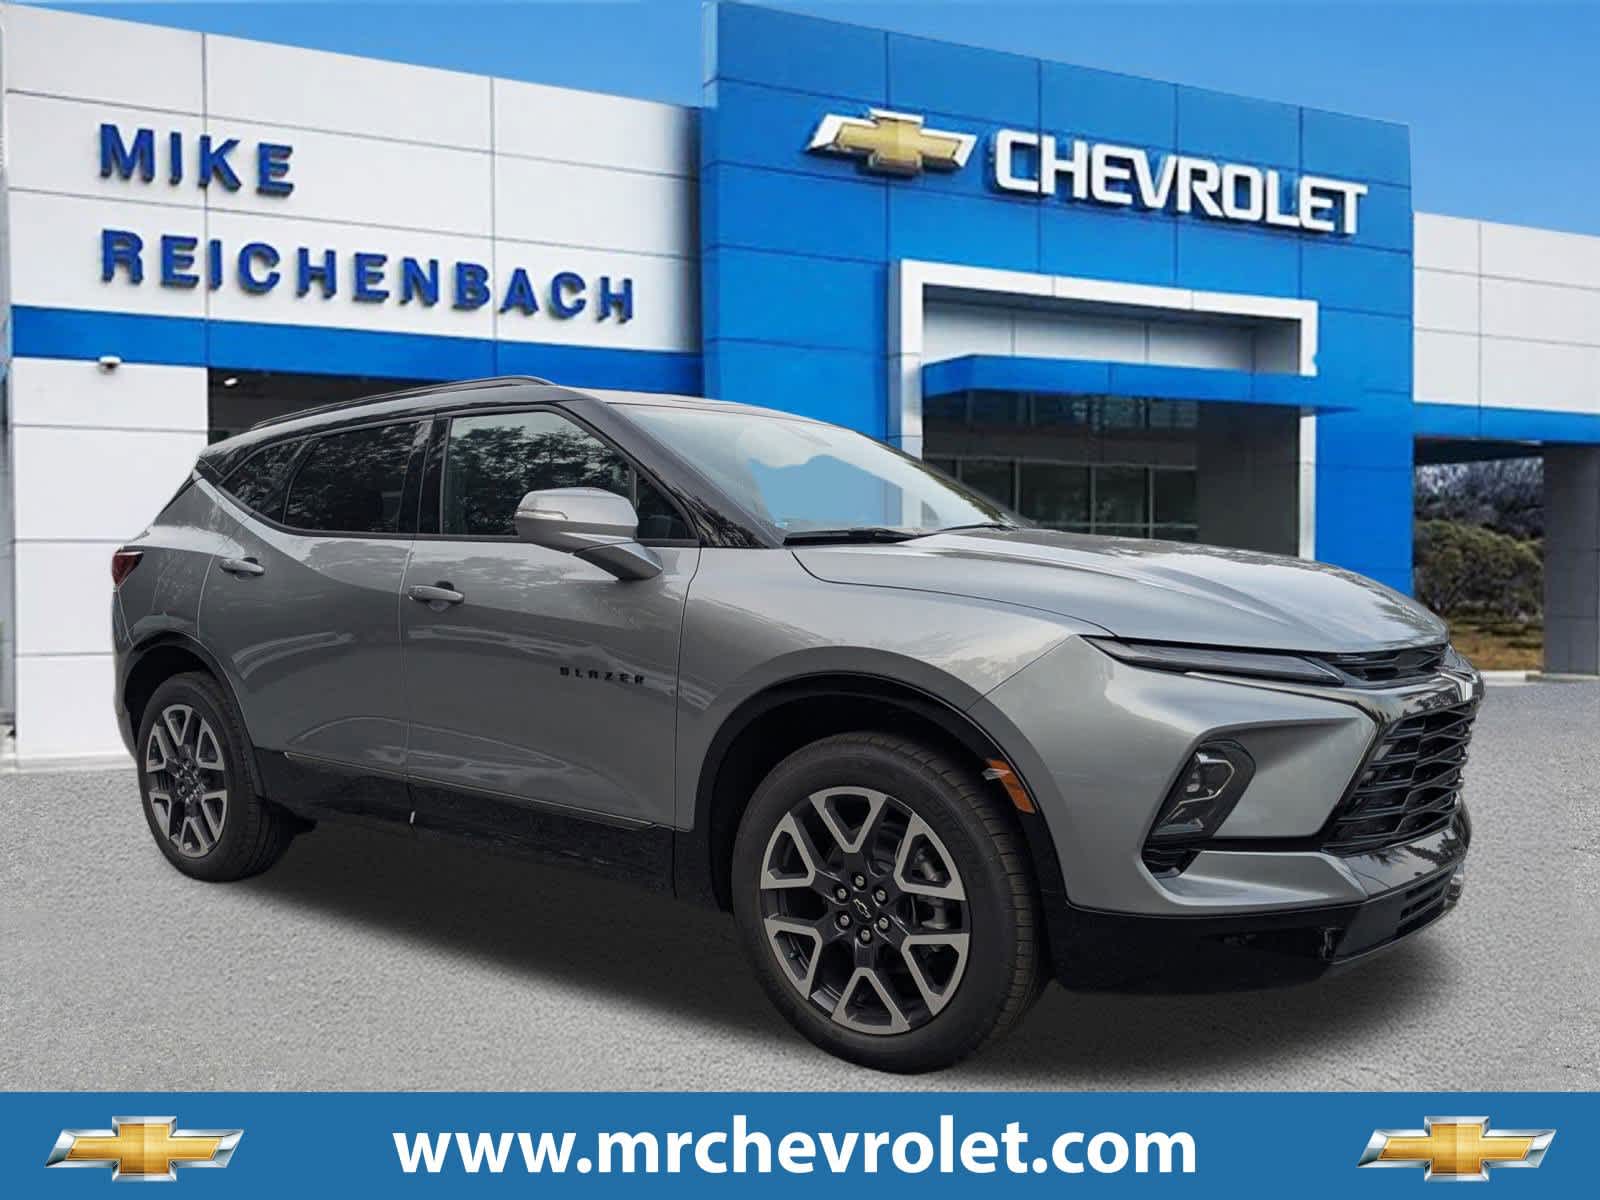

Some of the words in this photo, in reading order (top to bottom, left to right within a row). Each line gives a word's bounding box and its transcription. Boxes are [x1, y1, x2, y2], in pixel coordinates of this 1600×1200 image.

[99, 123, 295, 197] MIKE
[993, 128, 1368, 236] CHEVROLET
[101, 229, 635, 324] REICHENBACH
[560, 666, 645, 684] BLAZER
